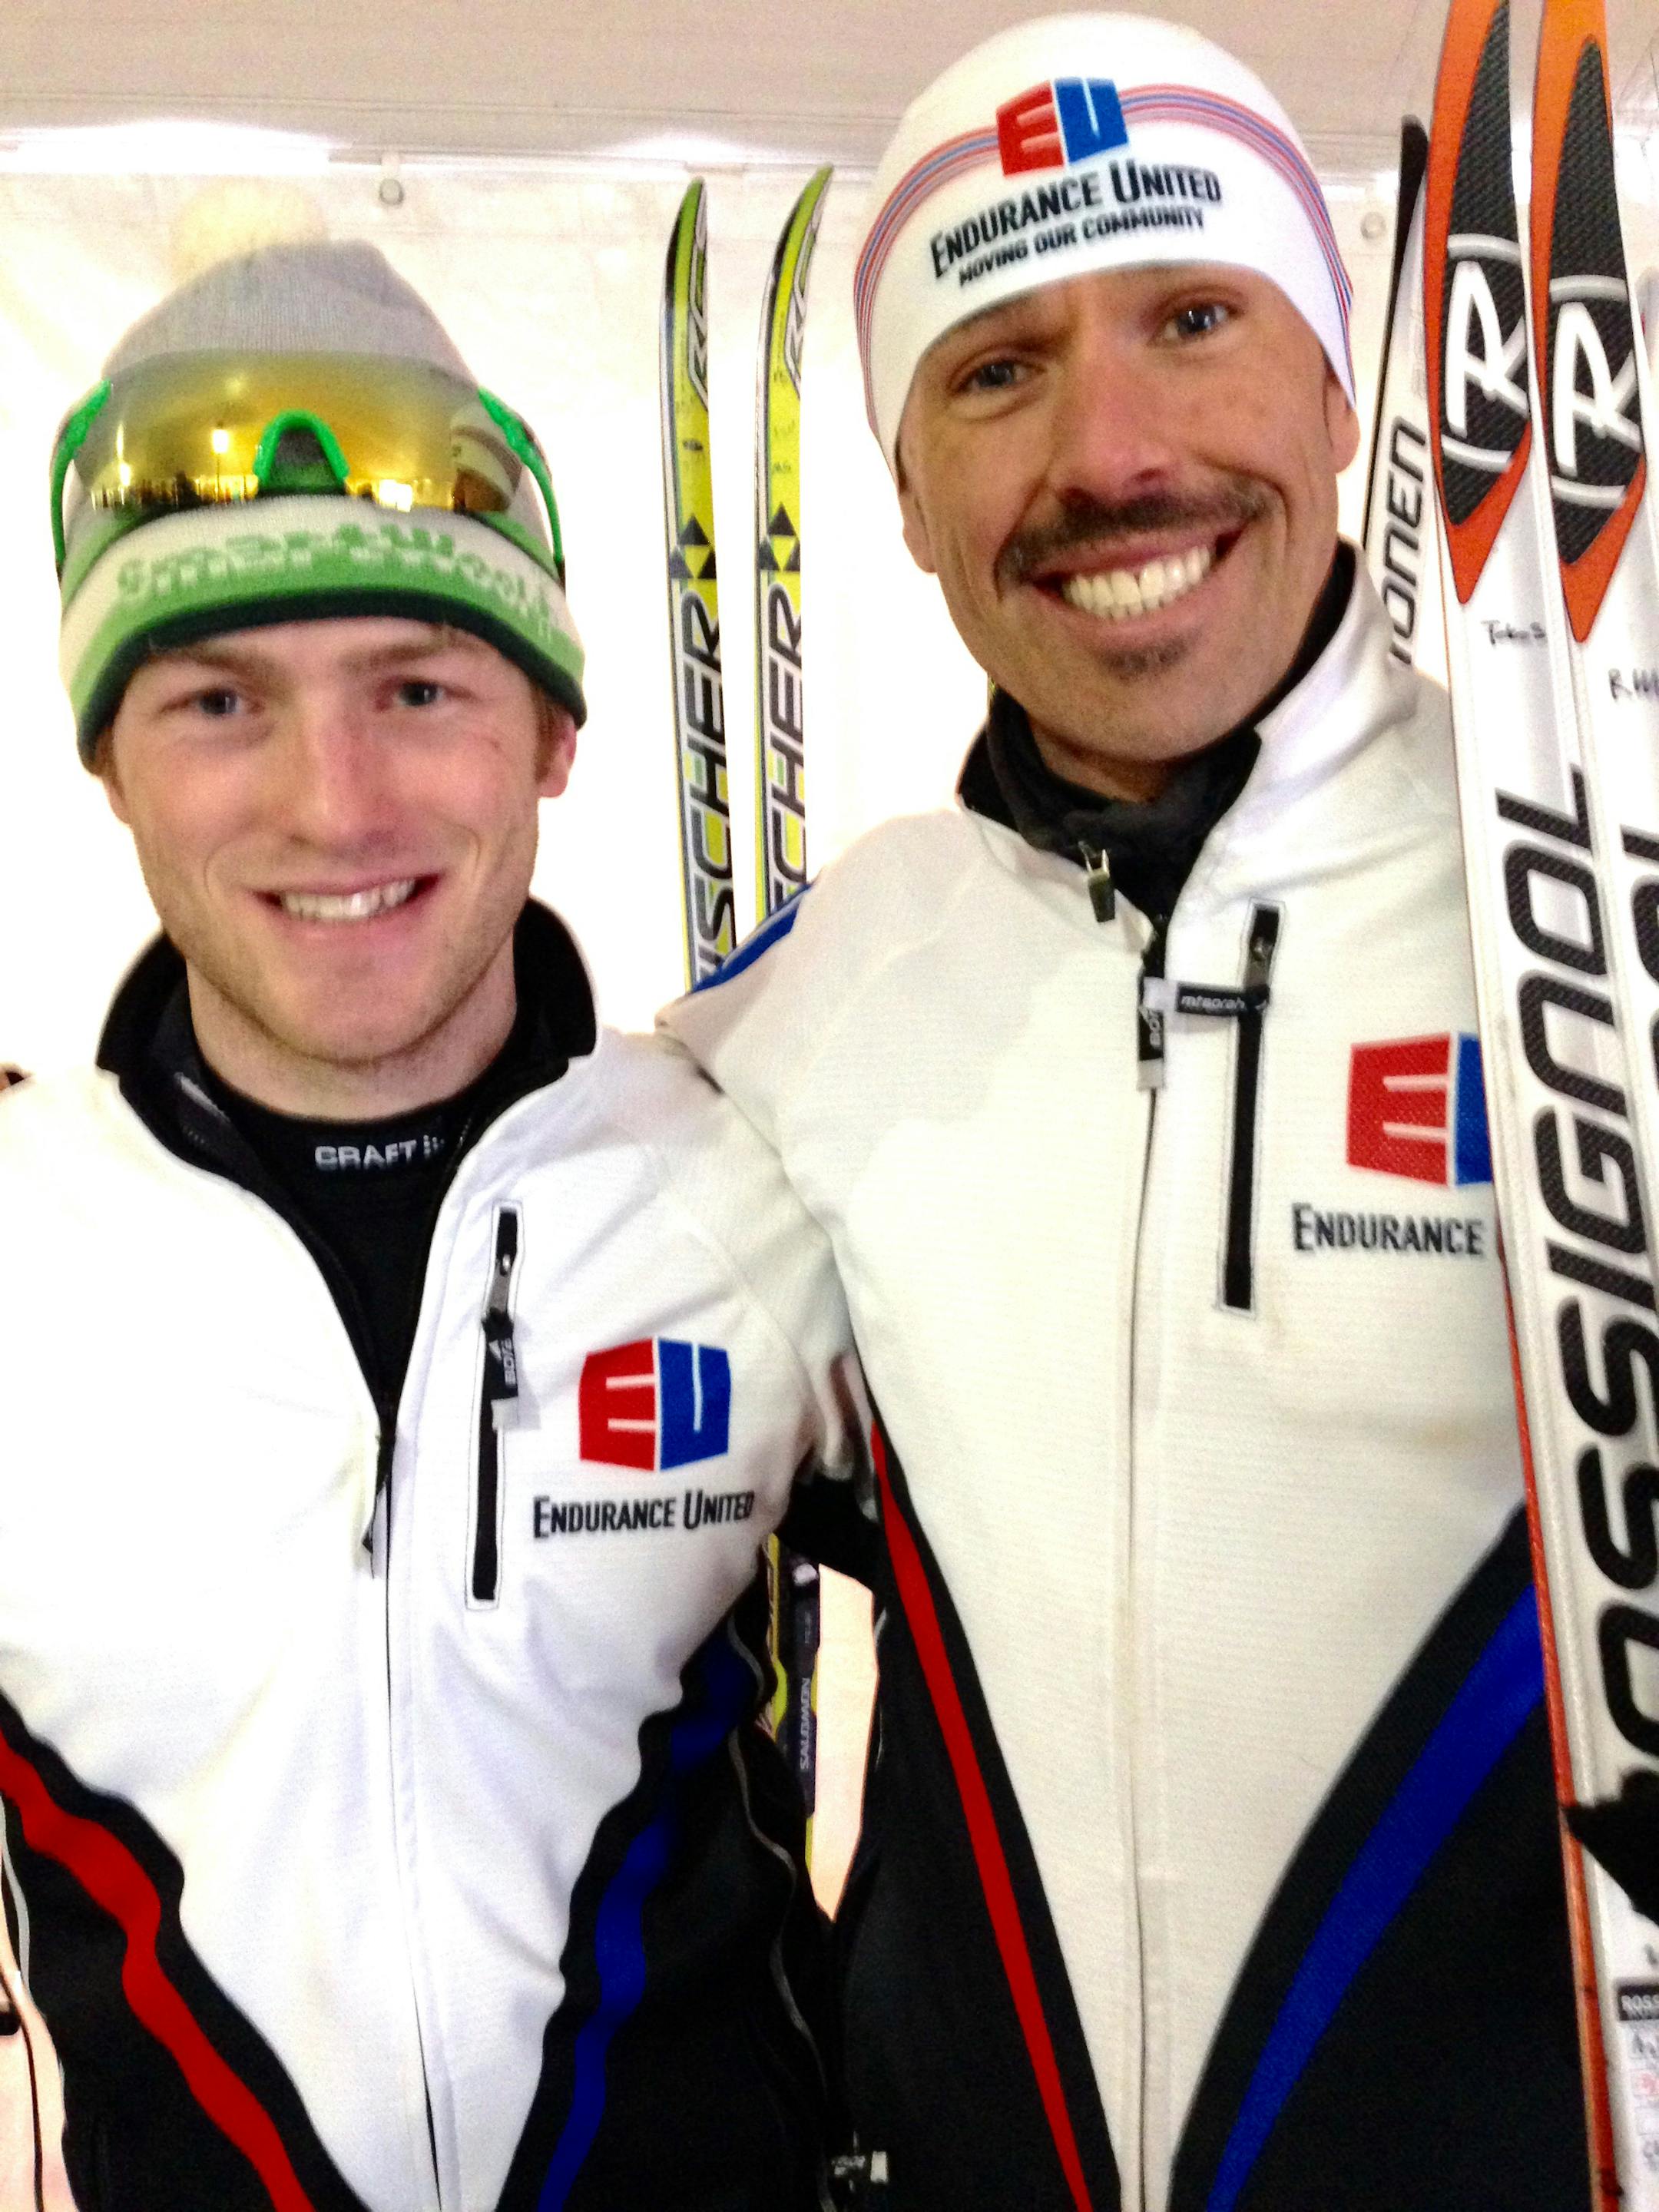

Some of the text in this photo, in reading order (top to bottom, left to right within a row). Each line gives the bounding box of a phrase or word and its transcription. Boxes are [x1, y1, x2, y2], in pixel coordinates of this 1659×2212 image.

[929, 157, 1223, 281] ENDURANCE UNITED
[958, 204, 1206, 289] MOVING OUR COMMUNITY
[315, 1139, 417, 1171] CRAFT
[1291, 1202, 1483, 1257] ENDURANCE
[1495, 763, 1659, 1801] OSSIGNOL
[533, 1488, 756, 1538] ENDURANCE UNITED
[800, 1677, 812, 1770] SALOMON
